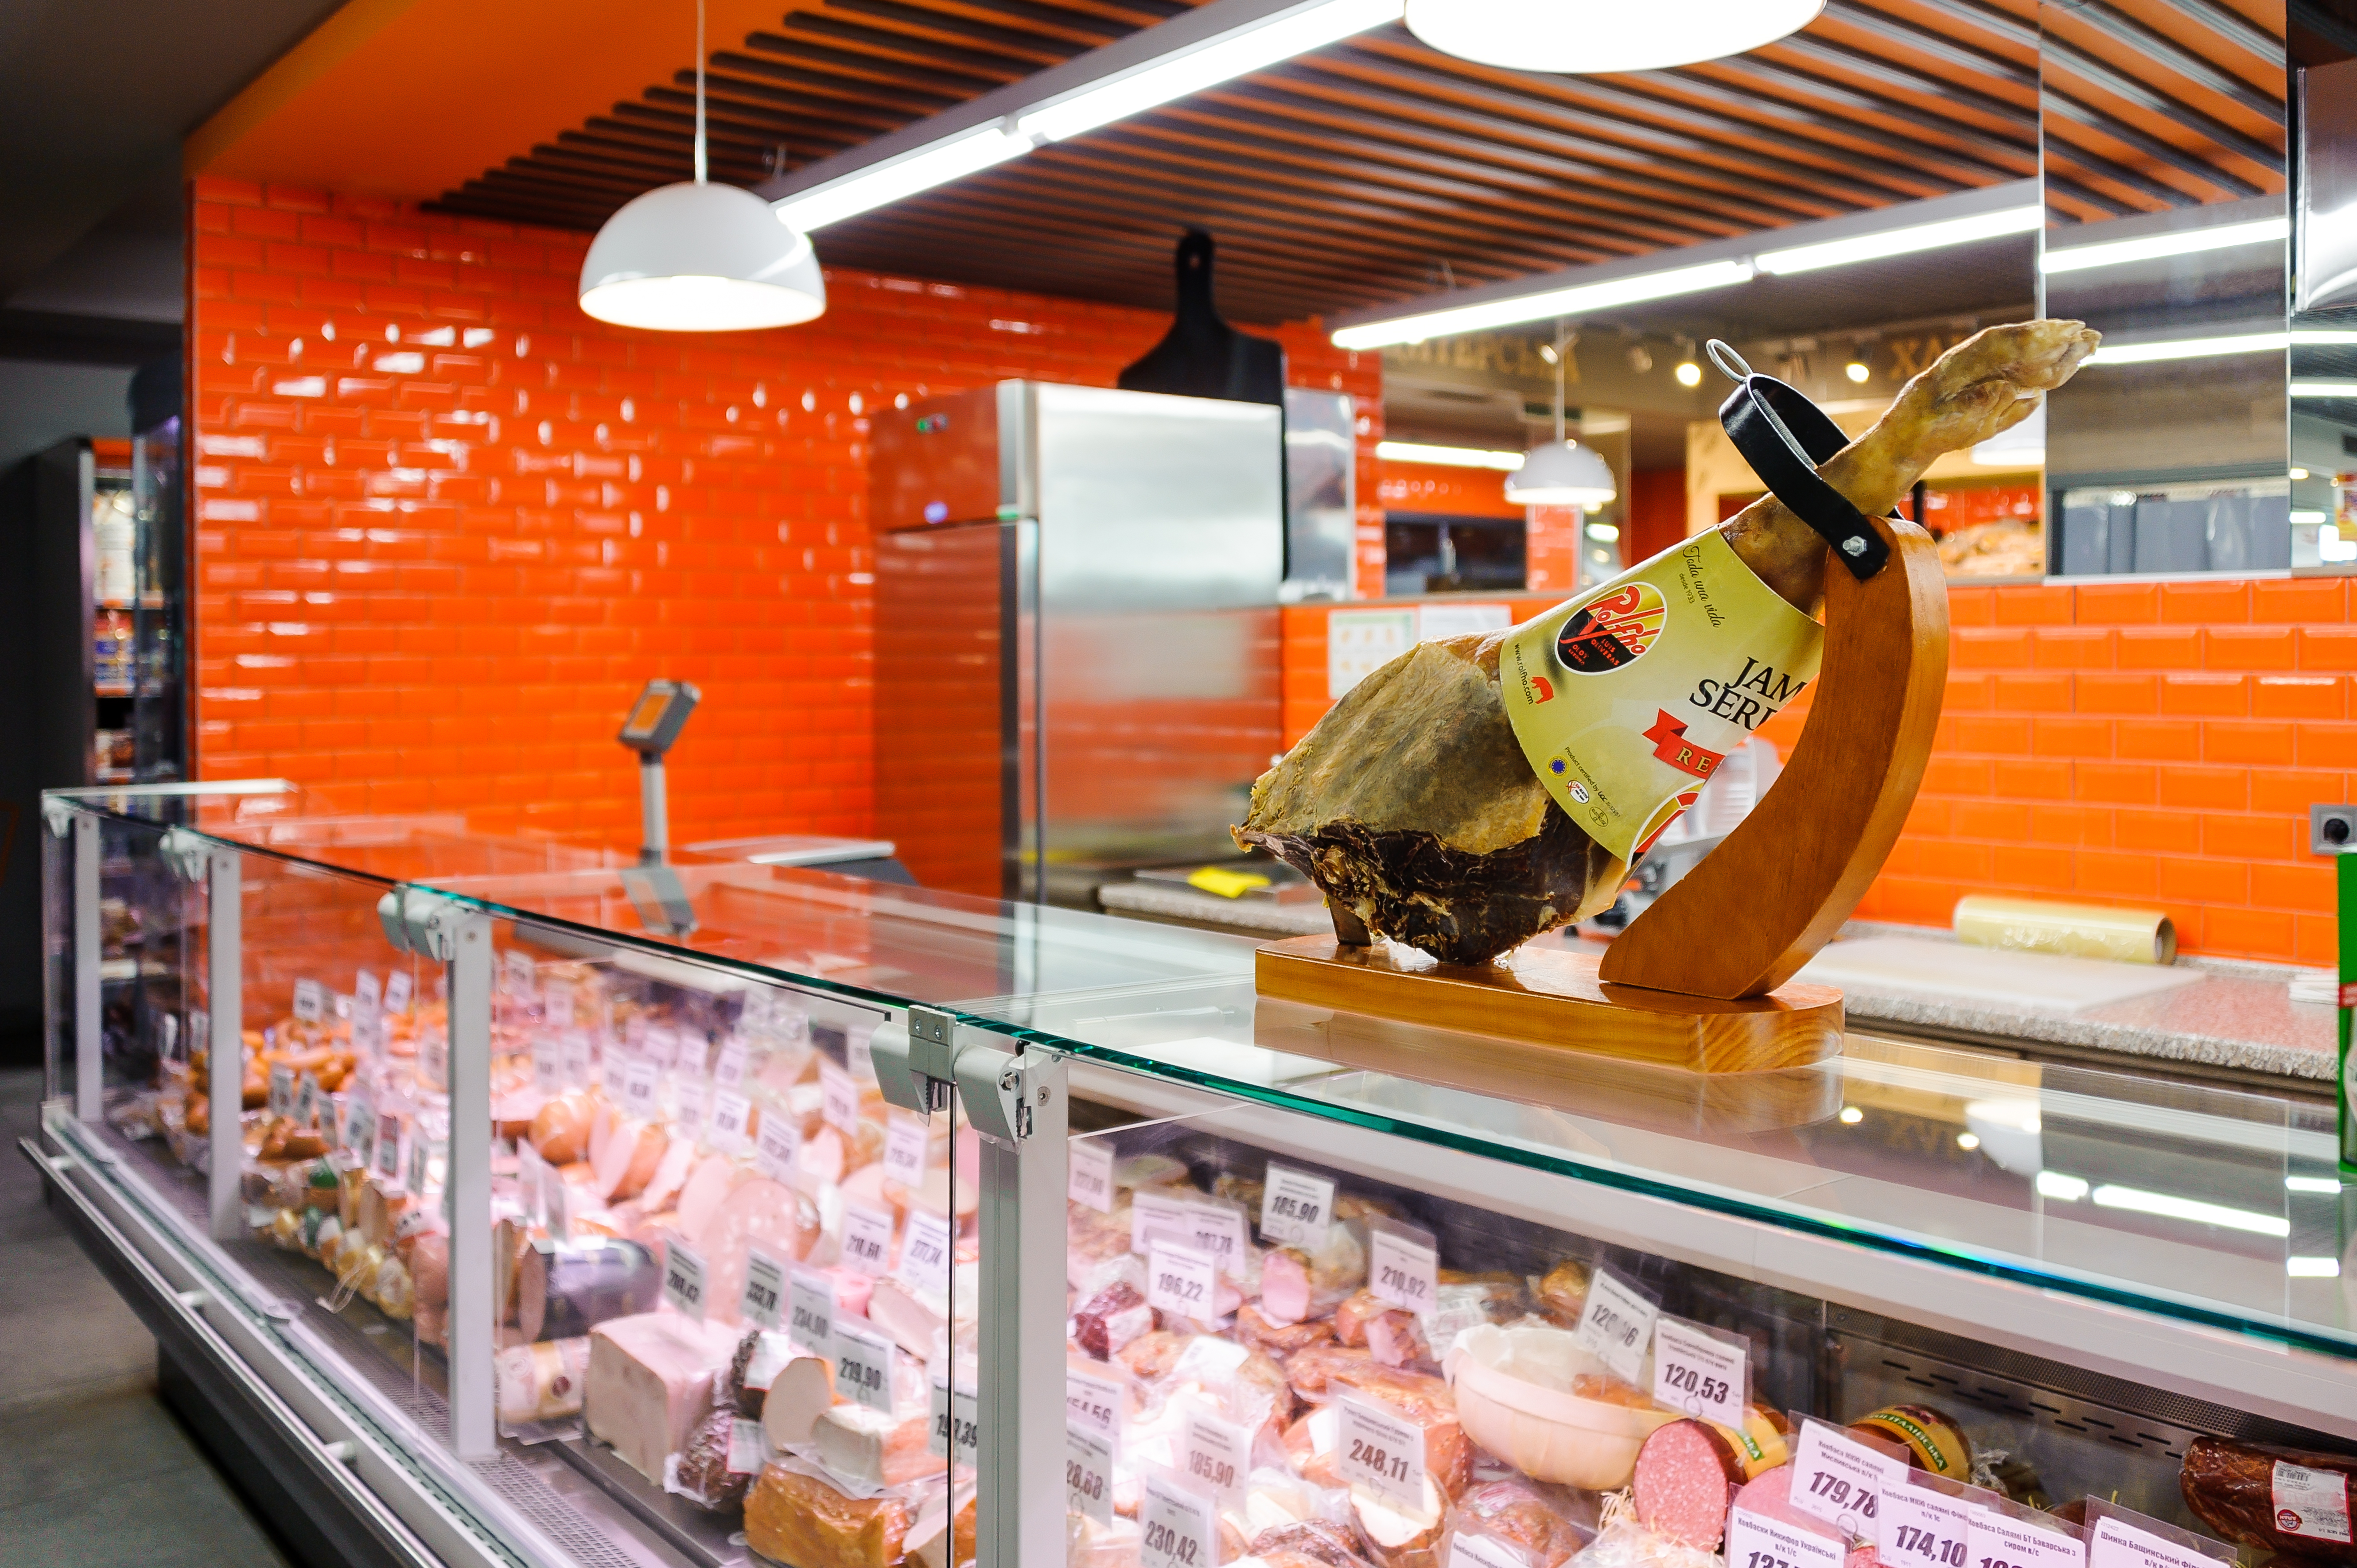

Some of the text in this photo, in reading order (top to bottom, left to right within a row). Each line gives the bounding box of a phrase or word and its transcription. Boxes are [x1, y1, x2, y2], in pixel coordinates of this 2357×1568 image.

[1679, 573, 1695, 604] desde 1933
[1683, 545, 1725, 628] Toda una vida
[1591, 639, 1620, 665] OLIVERAS
[1601, 638, 1616, 653] LUIS
[1514, 643, 1534, 705] www.rolfho.com
[1565, 747, 1579, 766] Product
[1578, 765, 1595, 786] certified
[1664, 1363, 1729, 1405] 120,53
[1349, 1438, 1409, 1483] 248,11
[1809, 1471, 1879, 1518] 179,78
[1145, 1520, 1197, 1566] 230,42
[1801, 1540, 1836, 1560] Українські
[1896, 1525, 1968, 1568] 174,10
[1997, 1527, 2022, 1541] Салямі
[2023, 1534, 2031, 1543] БТ
[2033, 1537, 2070, 1555] Баварська
[2004, 1541, 2040, 1557] сиром в/с
[2100, 1531, 2127, 1546] Шинка
[2129, 1541, 2179, 1566] Бащинський
